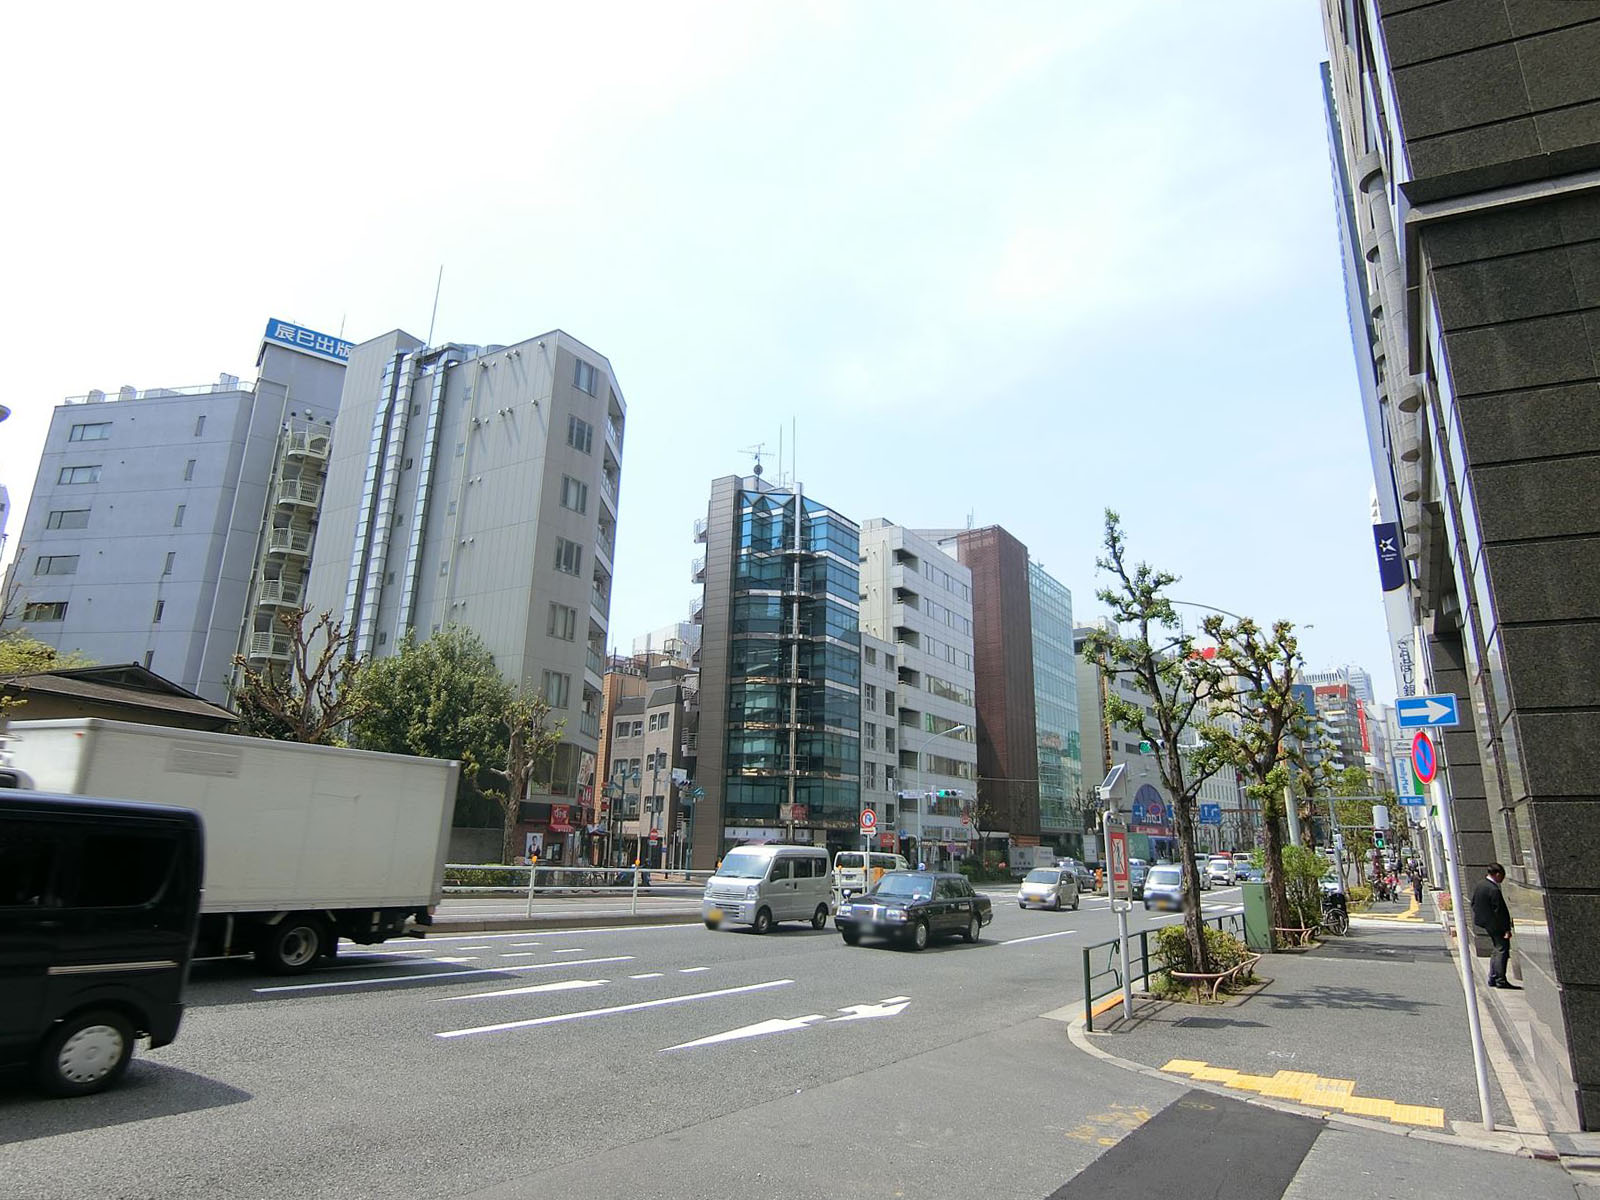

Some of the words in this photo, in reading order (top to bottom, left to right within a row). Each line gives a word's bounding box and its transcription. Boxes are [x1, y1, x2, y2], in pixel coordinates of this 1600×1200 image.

[275, 324, 354, 357] 辰巳出版
[1398, 758, 1410, 796] FamilyMart
